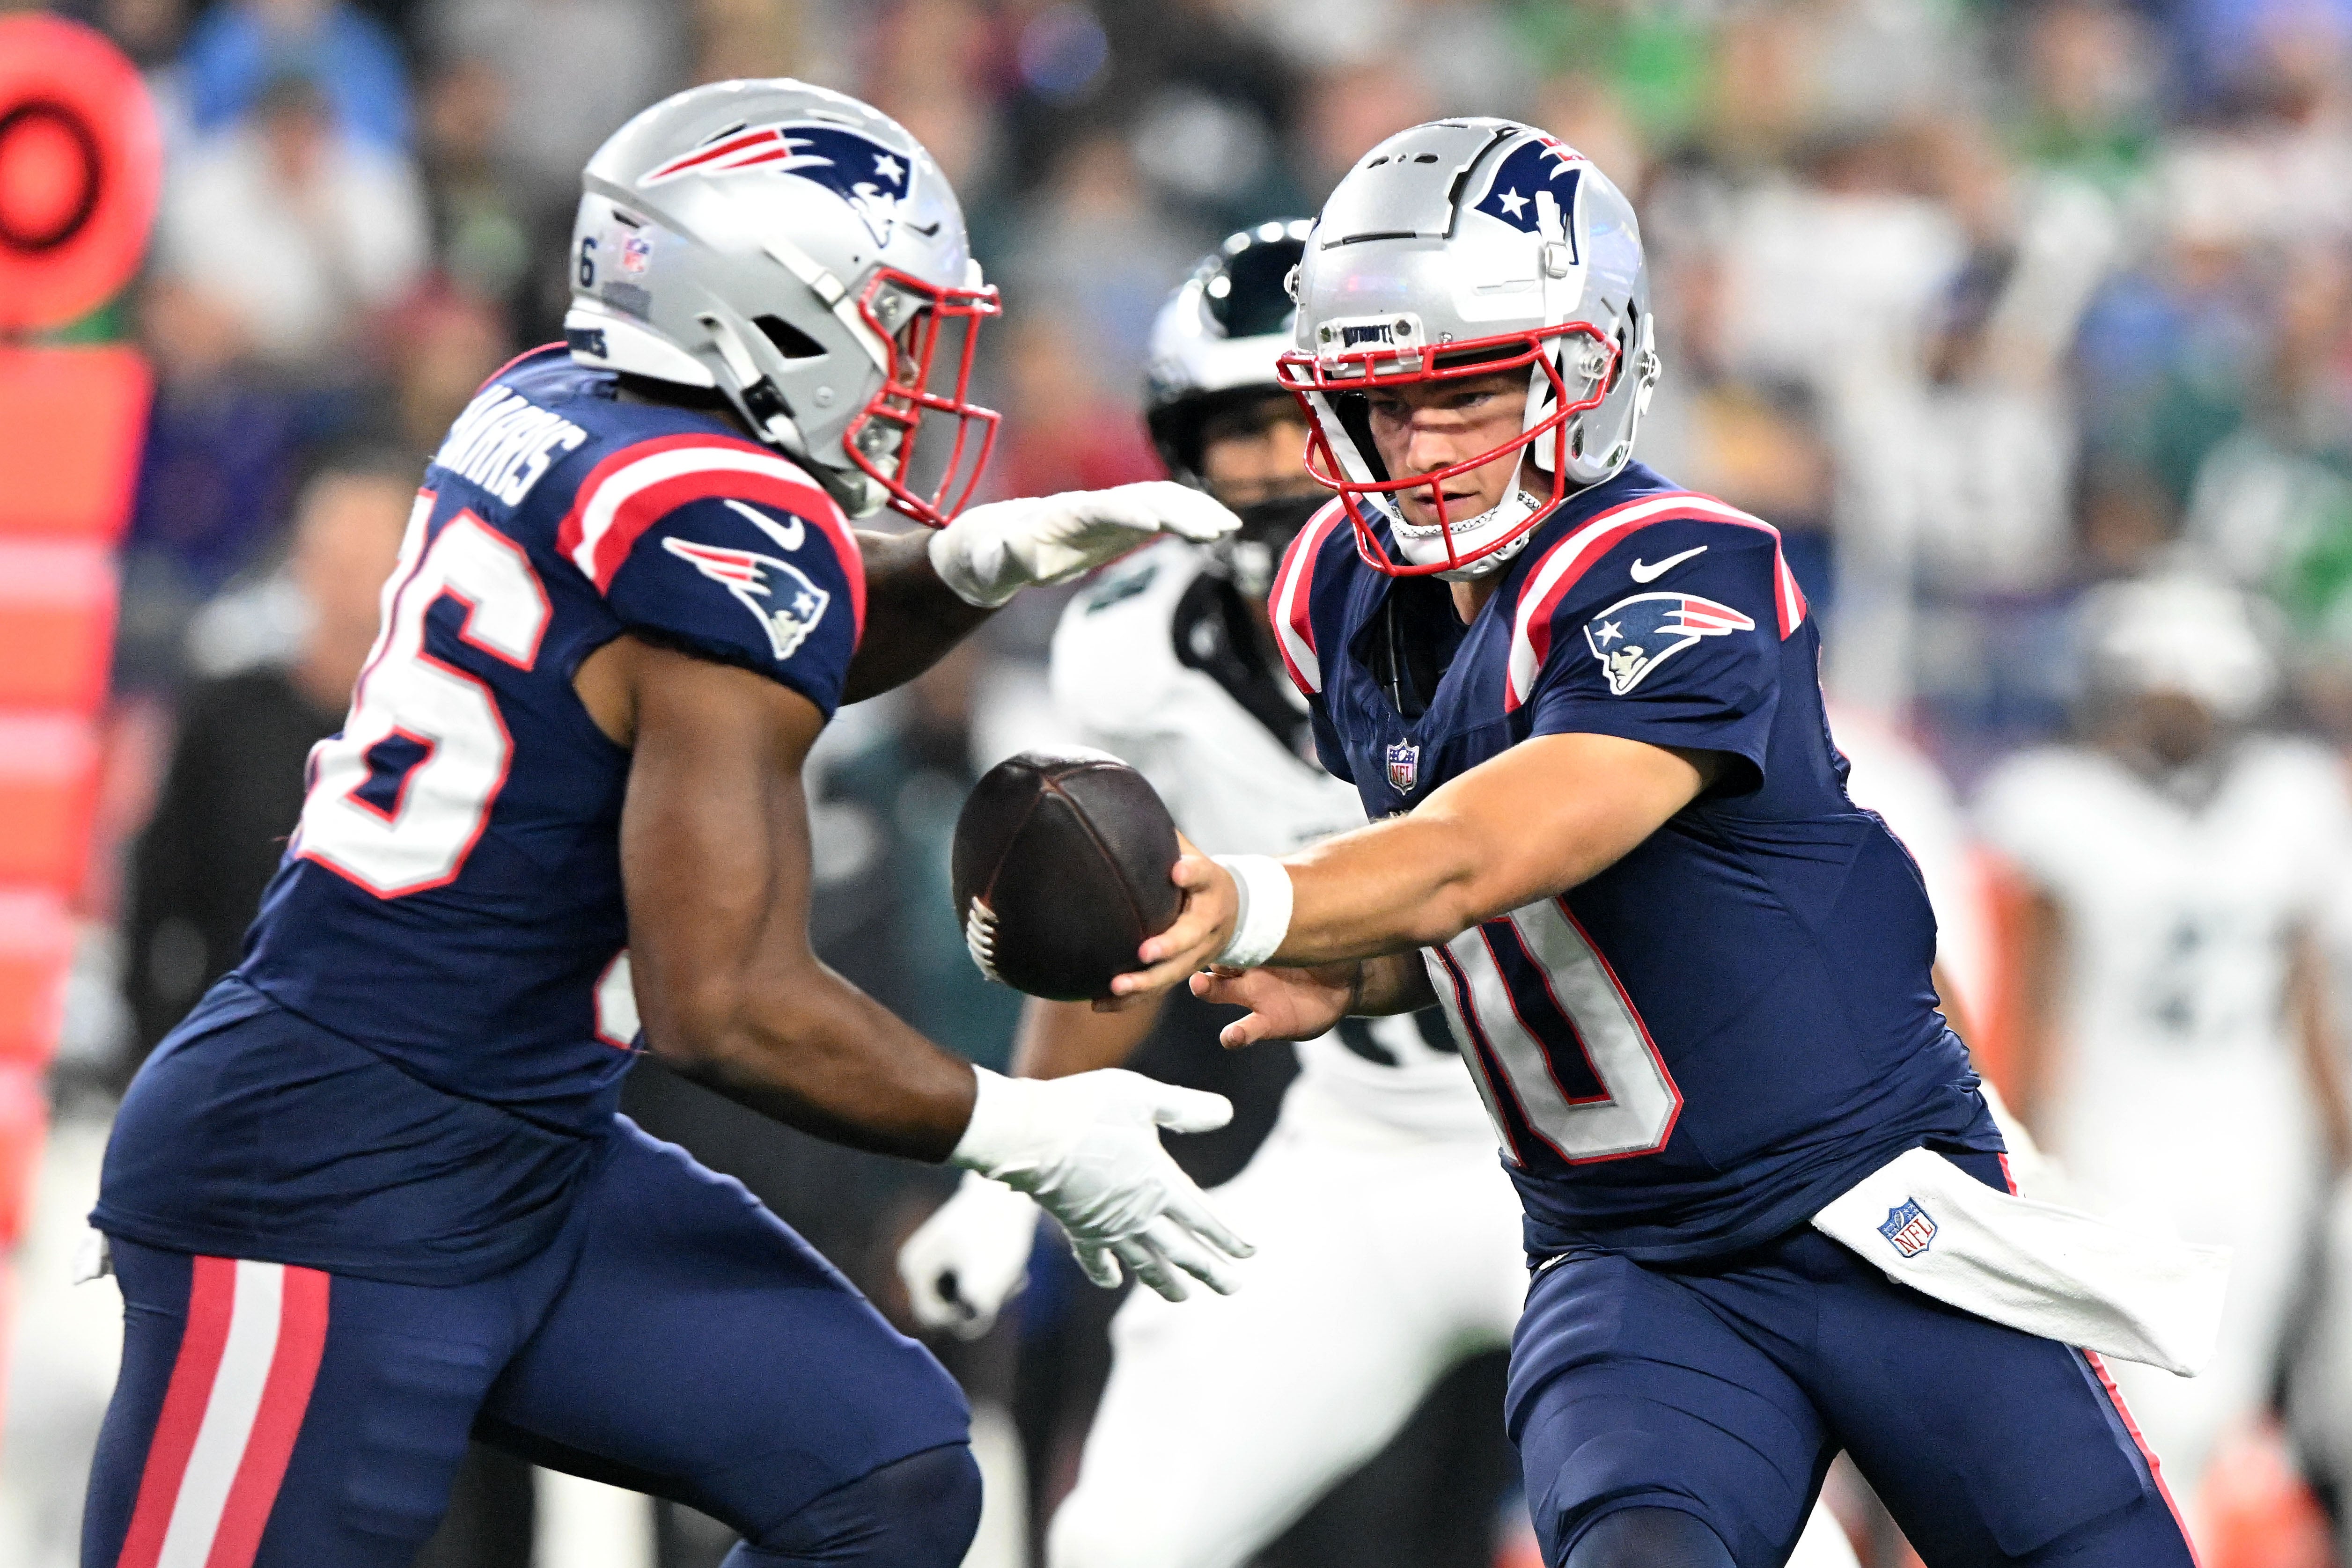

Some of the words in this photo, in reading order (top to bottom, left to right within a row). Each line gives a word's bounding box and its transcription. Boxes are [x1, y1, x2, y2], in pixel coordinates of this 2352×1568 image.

[295, 487, 553, 899] 6
[1391, 765, 1411, 784] NFL
[1894, 1218, 1933, 1254] NFL
